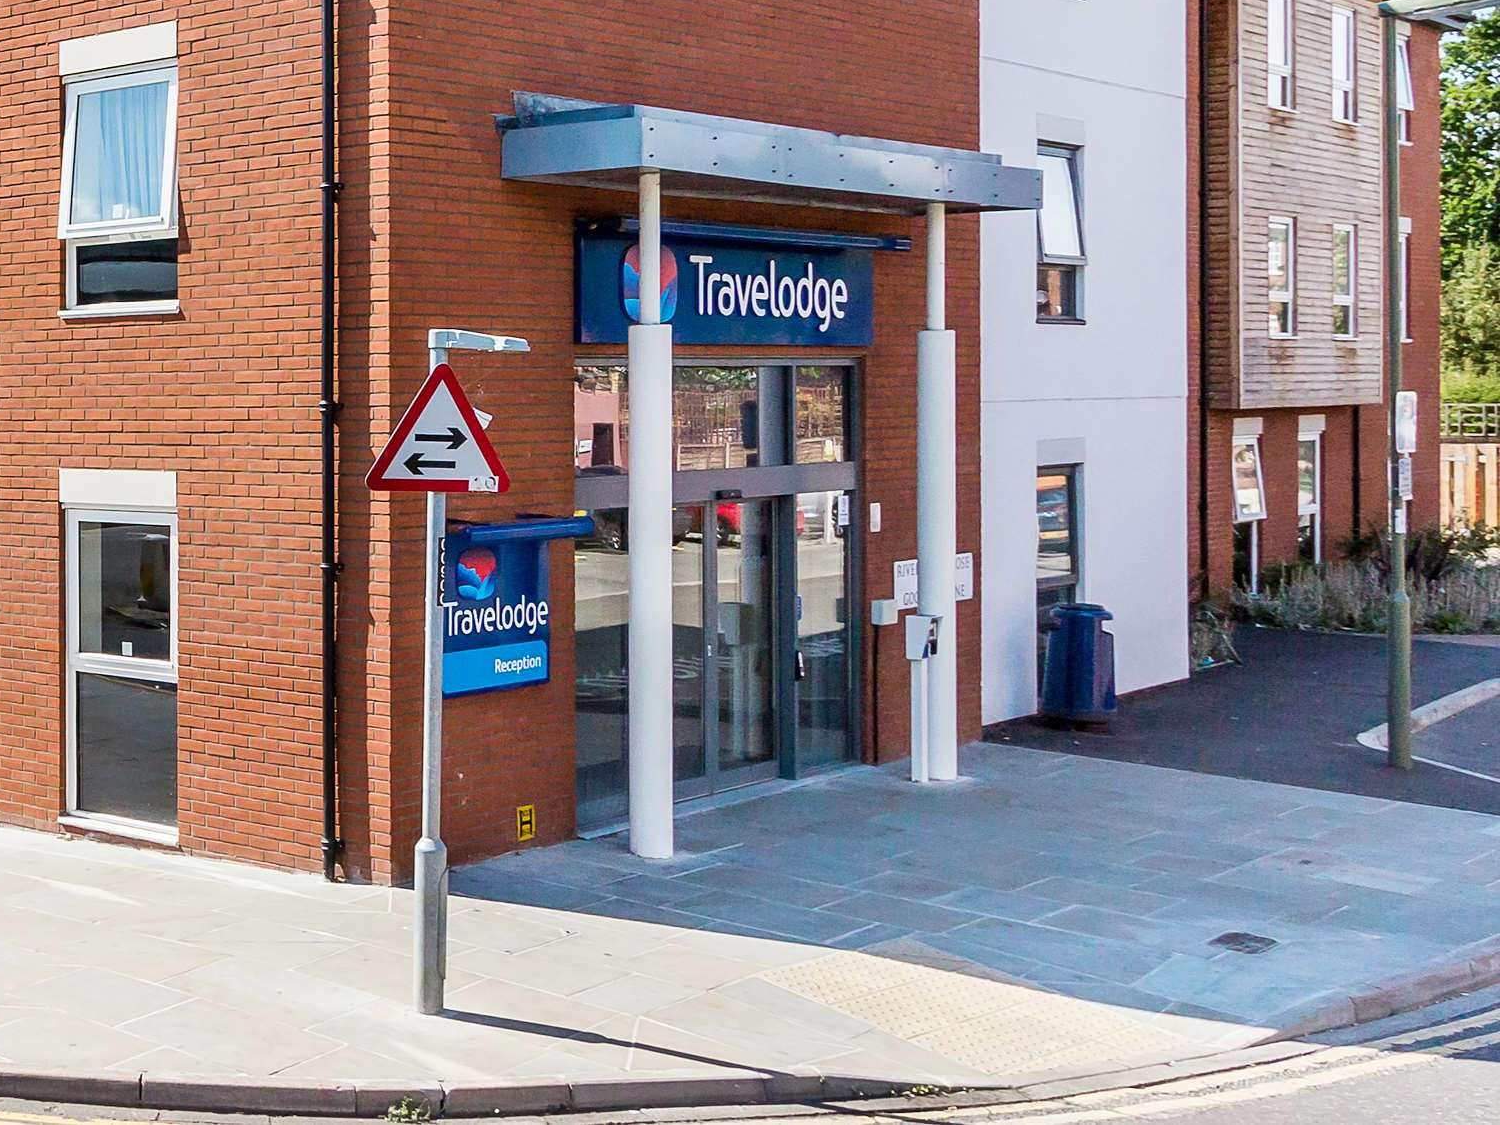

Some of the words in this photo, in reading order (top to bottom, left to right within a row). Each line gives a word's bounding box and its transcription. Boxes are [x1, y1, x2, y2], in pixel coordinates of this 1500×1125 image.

[689, 254, 848, 333] Travelodge
[443, 594, 549, 637] Travelodge
[494, 654, 542, 674] Reception
